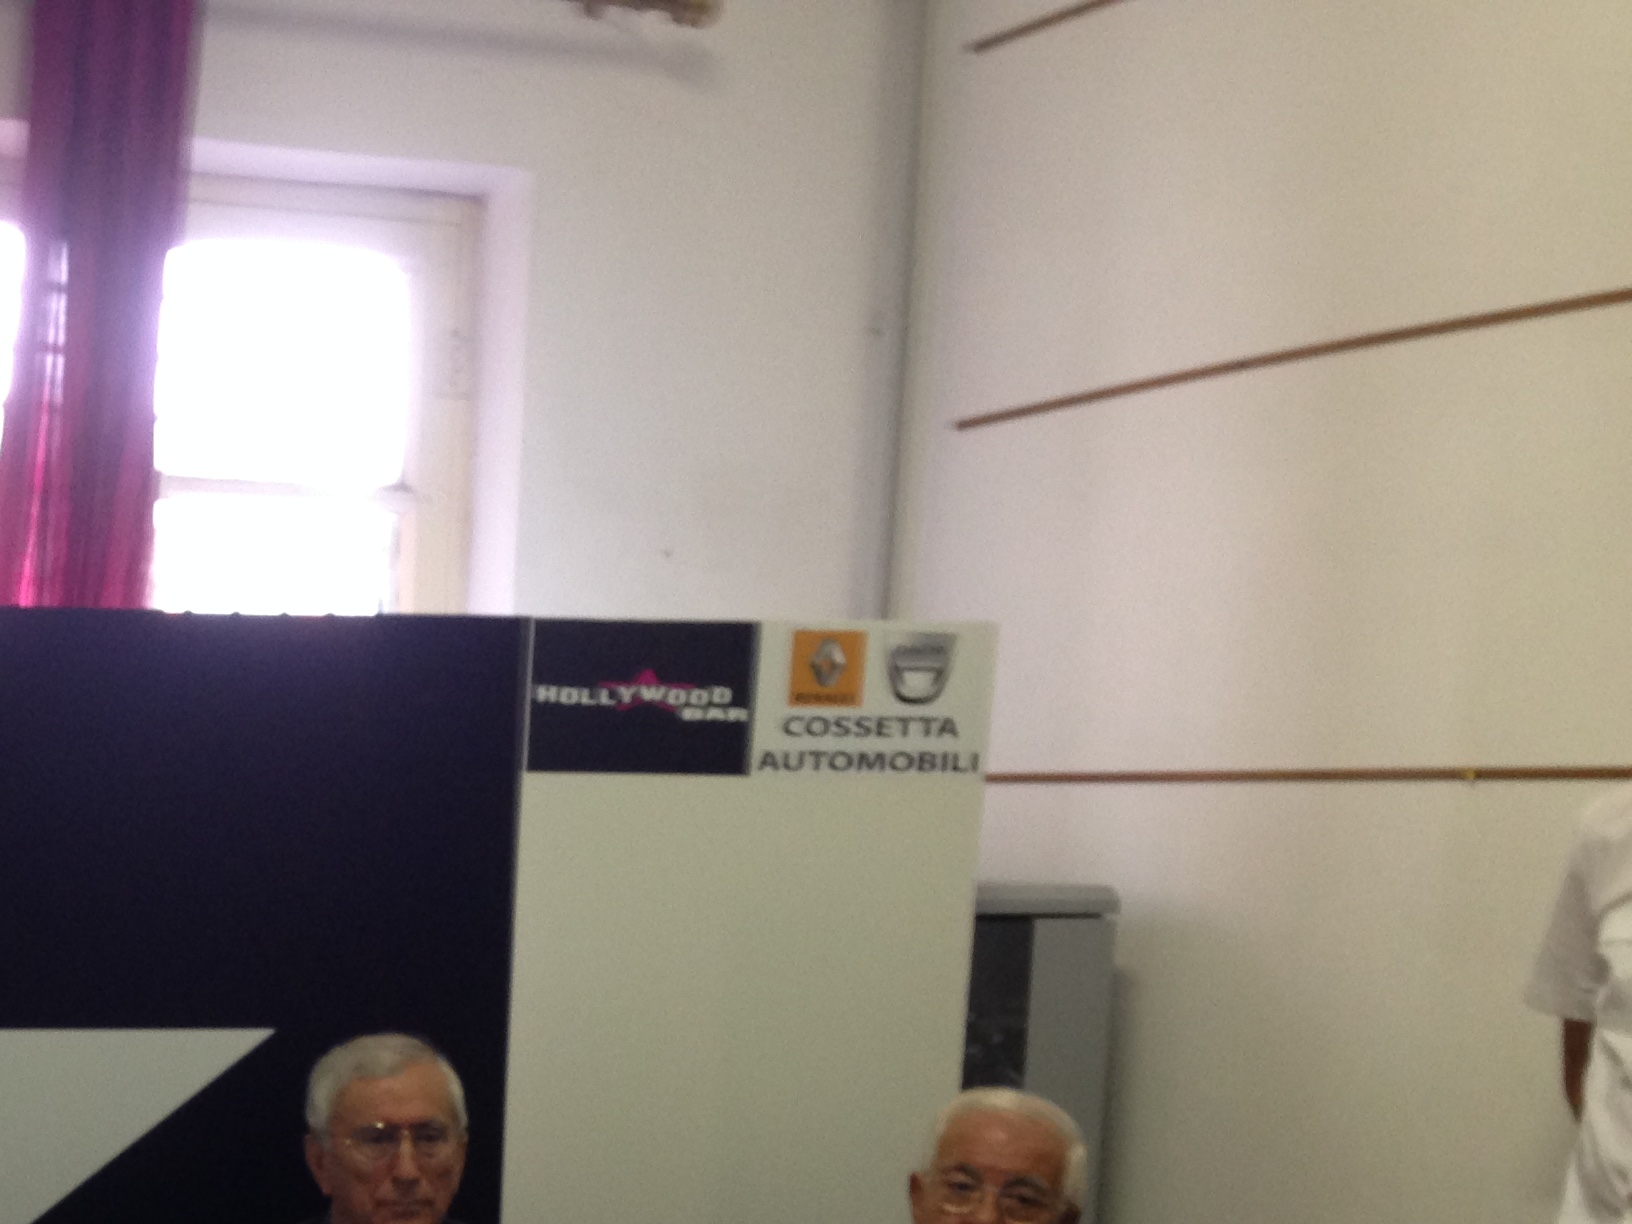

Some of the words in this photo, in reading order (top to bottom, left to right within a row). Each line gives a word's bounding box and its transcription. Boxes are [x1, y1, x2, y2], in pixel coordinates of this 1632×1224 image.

[534, 684, 734, 707] HOLLYWOOD
[782, 715, 960, 740] COSSETTA
[758, 749, 981, 776] AUTOMOBILI
